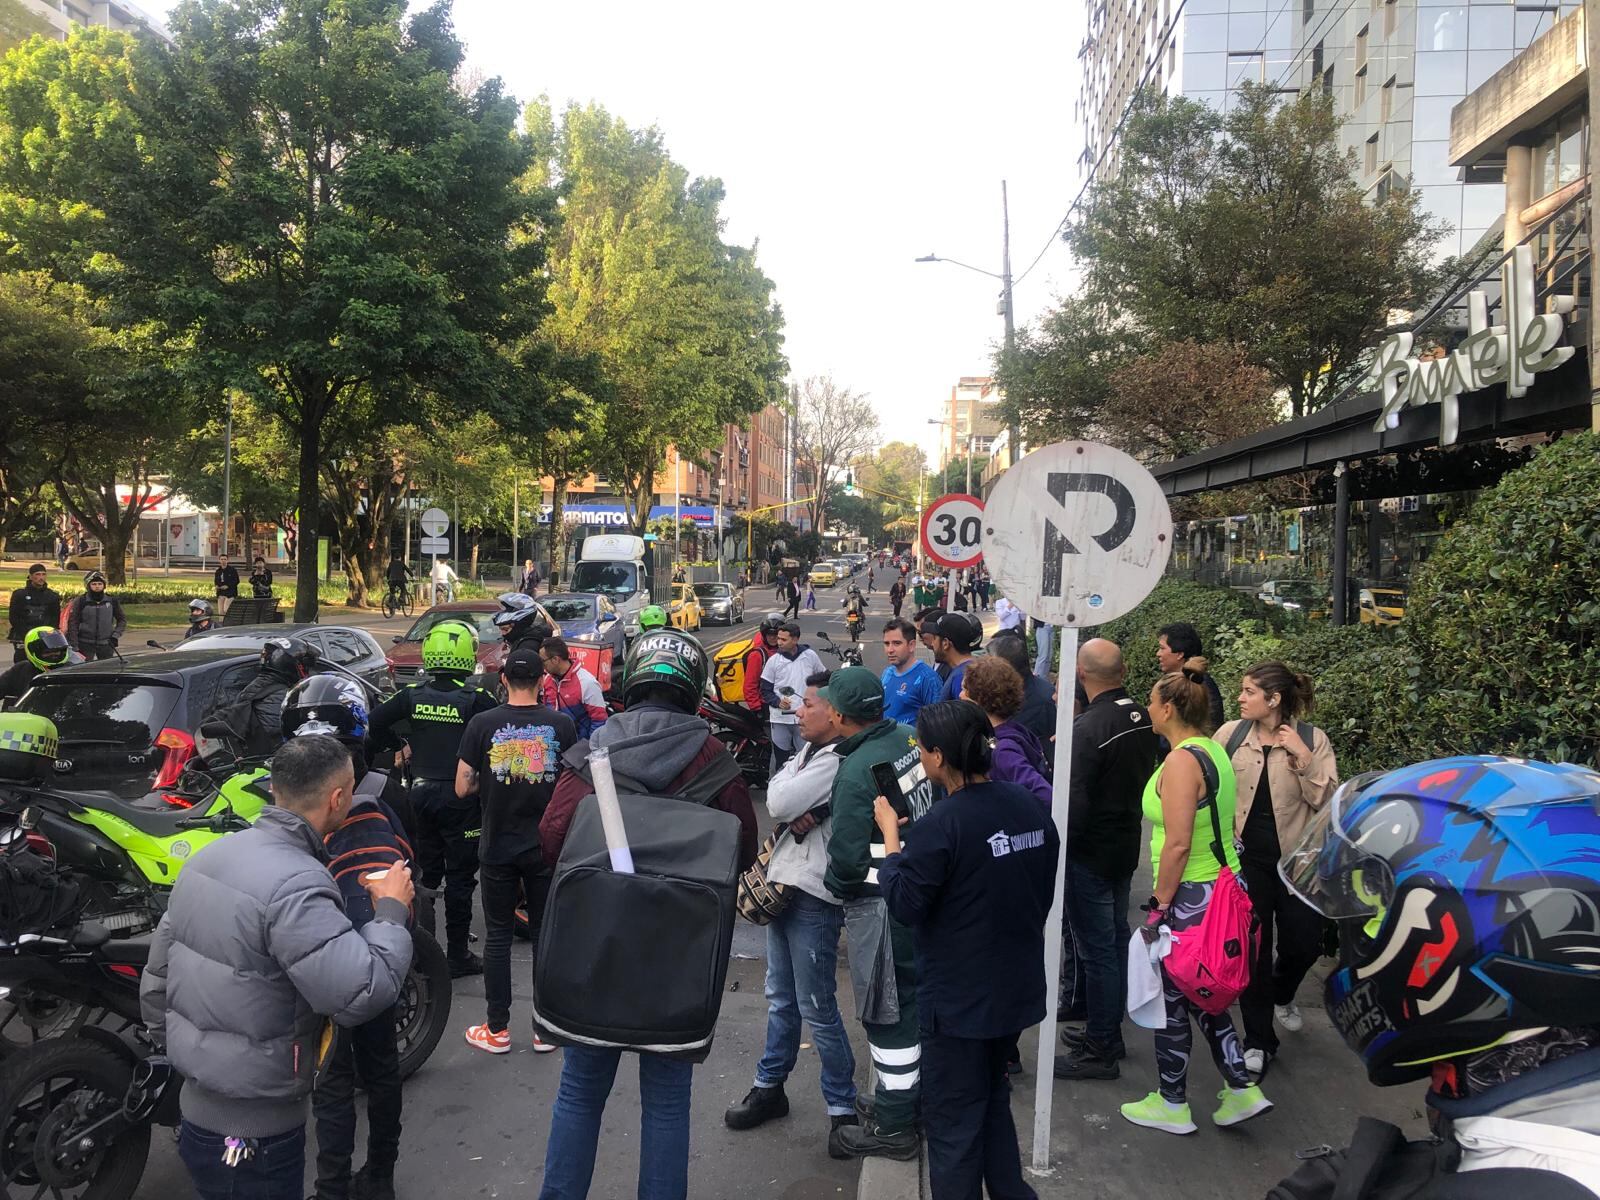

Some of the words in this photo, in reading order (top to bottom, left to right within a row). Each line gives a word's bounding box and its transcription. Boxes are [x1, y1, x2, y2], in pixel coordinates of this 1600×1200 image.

[933, 513, 982, 547] 30
[639, 638, 699, 665] AKH-18F
[415, 703, 459, 718] POLICÍA
